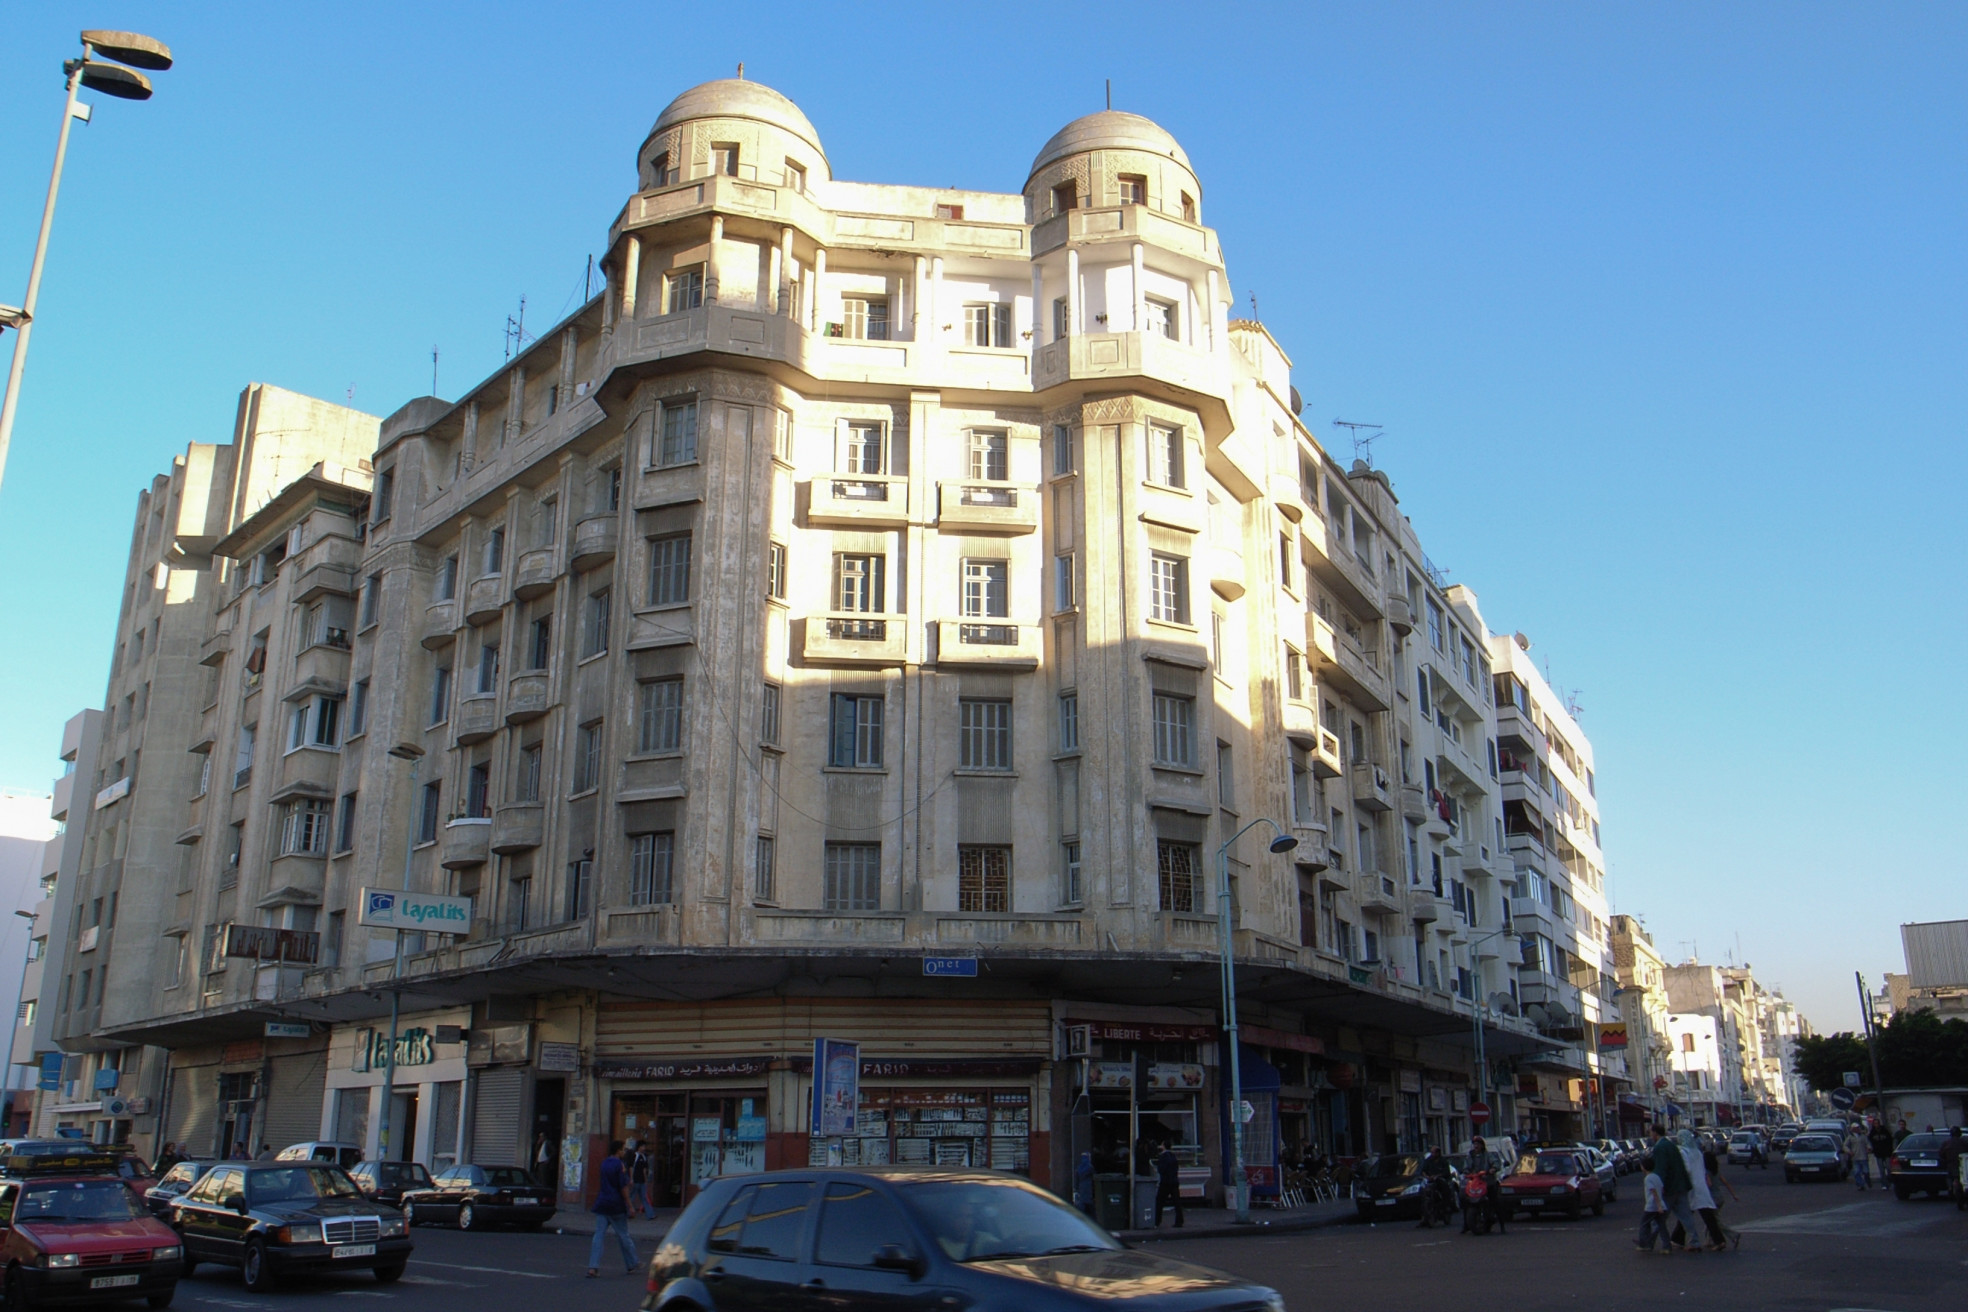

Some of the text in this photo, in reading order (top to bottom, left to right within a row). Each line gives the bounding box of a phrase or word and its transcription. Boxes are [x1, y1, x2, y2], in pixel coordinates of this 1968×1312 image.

[1104, 1028, 1141, 1040] LIBERTE
[646, 1065, 675, 1078] FARID
[863, 1063, 909, 1075] FARID
